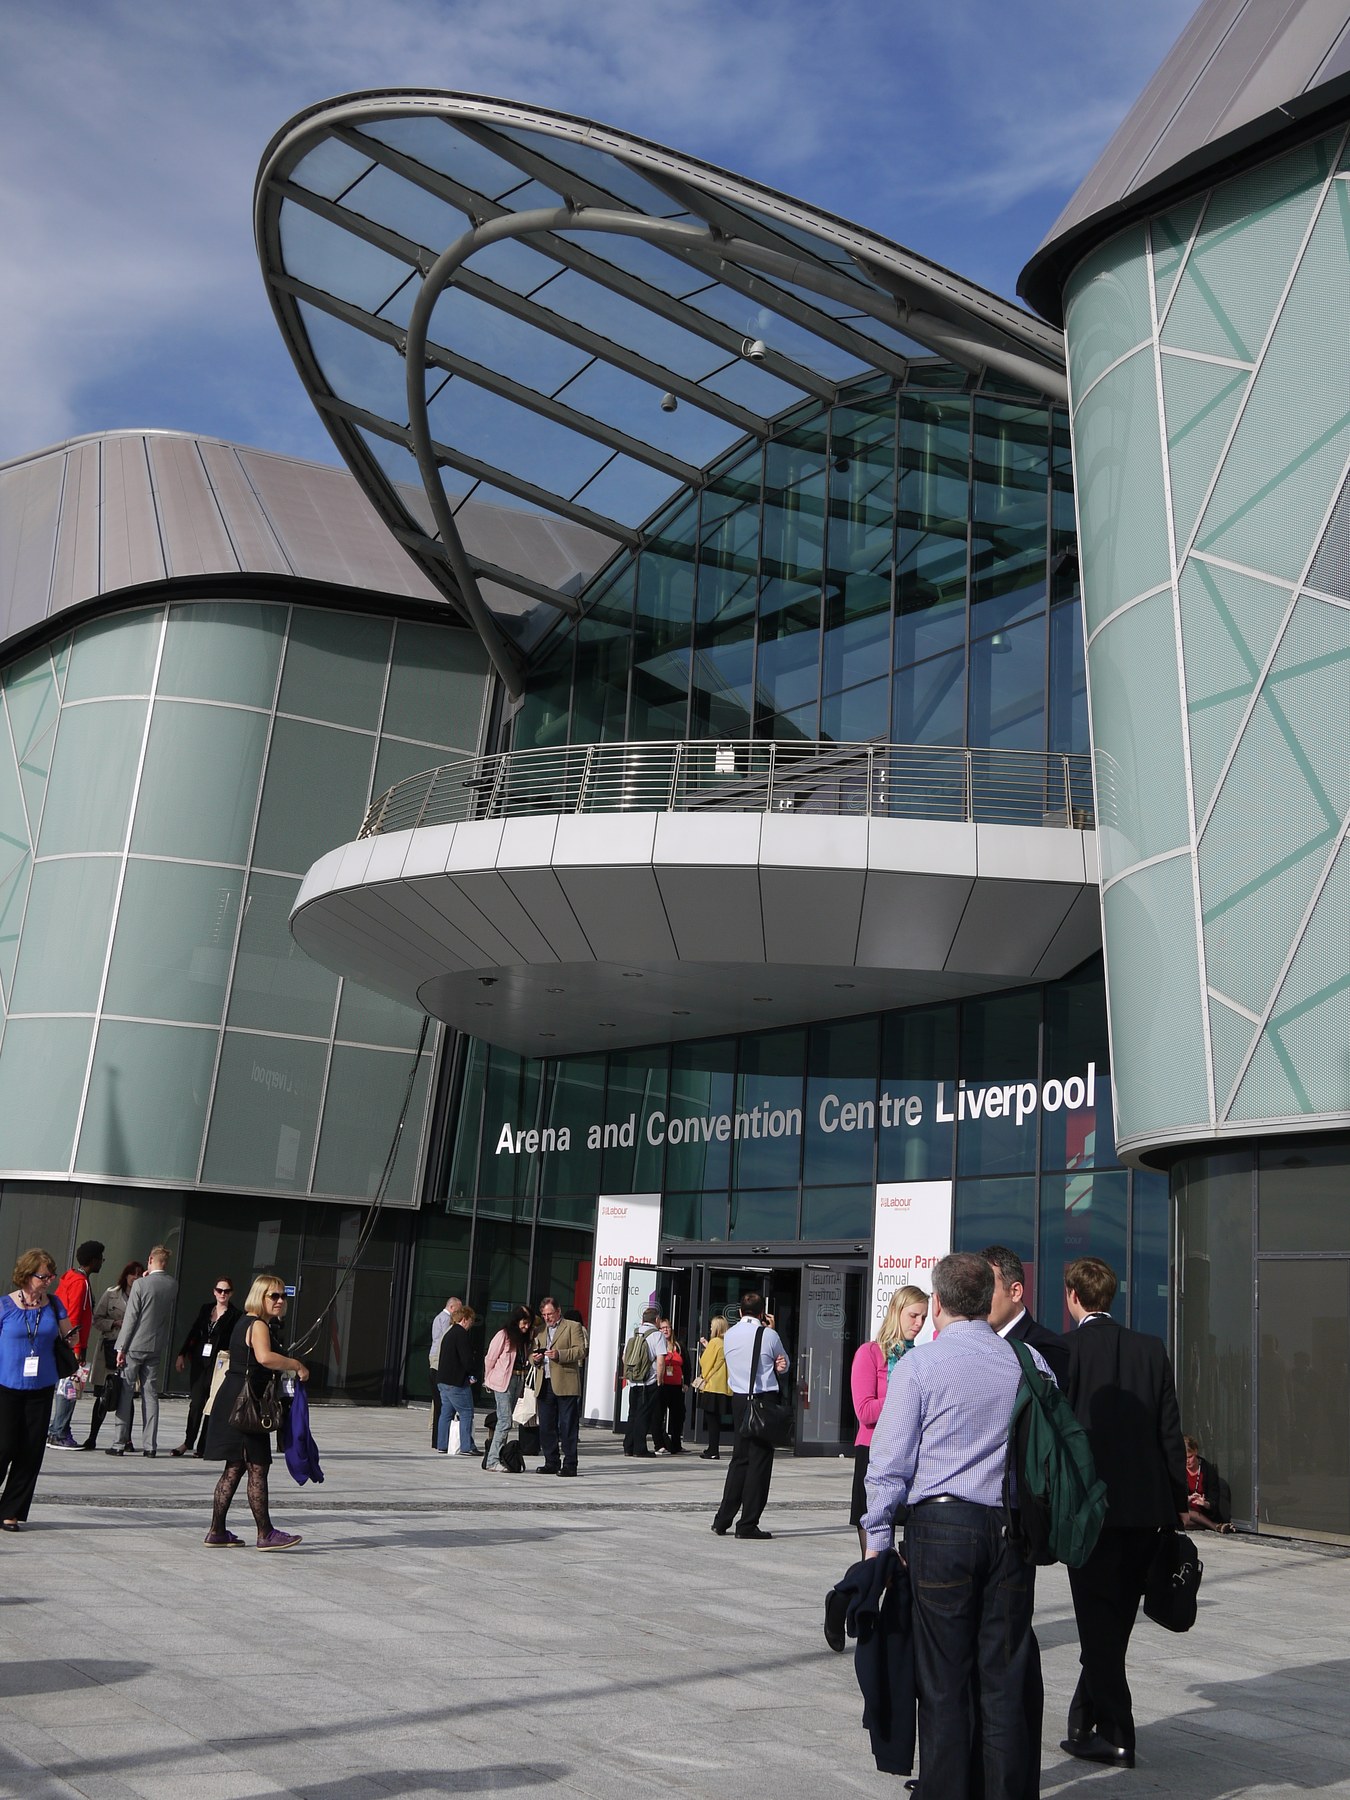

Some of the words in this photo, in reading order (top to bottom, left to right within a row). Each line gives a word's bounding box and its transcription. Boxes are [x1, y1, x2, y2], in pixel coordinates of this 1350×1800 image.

[495, 1122, 571, 1155] Arena
[587, 1113, 636, 1150] and
[646, 1100, 802, 1146] Convention
[819, 1091, 923, 1133] Centre
[936, 1062, 1096, 1126] Liverpool
[886, 1197, 912, 1208] Labour
[606, 1206, 628, 1216] Labour
[599, 1254, 627, 1267] Labour
[878, 1254, 913, 1269] Labour
[597, 1269, 622, 1281] Annua
[877, 1271, 910, 1286] Annual
[595, 1296, 617, 1309] 2011
